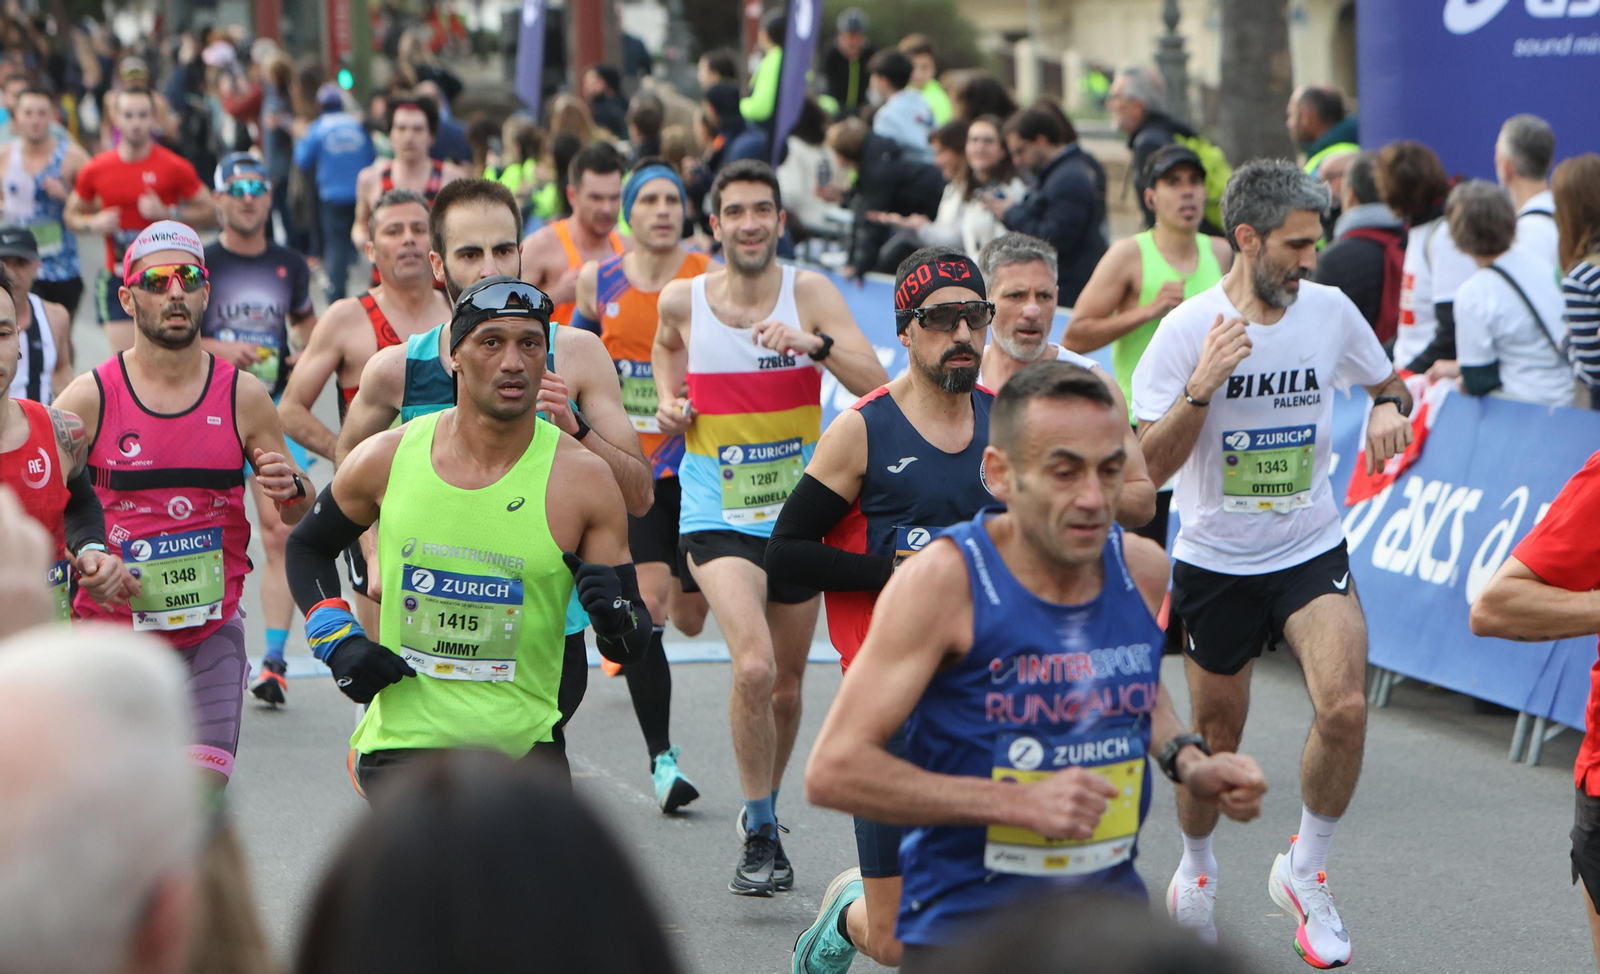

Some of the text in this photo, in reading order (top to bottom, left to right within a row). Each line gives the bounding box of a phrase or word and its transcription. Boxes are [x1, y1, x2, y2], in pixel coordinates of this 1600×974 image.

[1513, 32, 1575, 57] sound
[895, 264, 932, 310] OTSO
[1226, 367, 1320, 399] BIKILA
[1274, 394, 1322, 409] PALENCIA
[1255, 430, 1307, 446] ZURICH
[748, 442, 794, 460] ZURICH
[1256, 459, 1288, 474] 1343
[750, 471, 778, 486] 1287
[1252, 482, 1294, 494] OTTITTO
[744, 490, 788, 506] CANDELA
[1371, 475, 1484, 585] asics
[422, 543, 525, 570] FRONTRUNNER
[161, 567, 197, 585] 1348
[487, 566, 522, 581] FRANCE
[442, 578, 510, 599] ZURICH
[165, 592, 200, 608] SANTI
[438, 612, 479, 632] 1415
[432, 640, 480, 657] JIMMY
[1017, 643, 1153, 685] INTERSPORT
[1052, 736, 1130, 766] ZURICH
